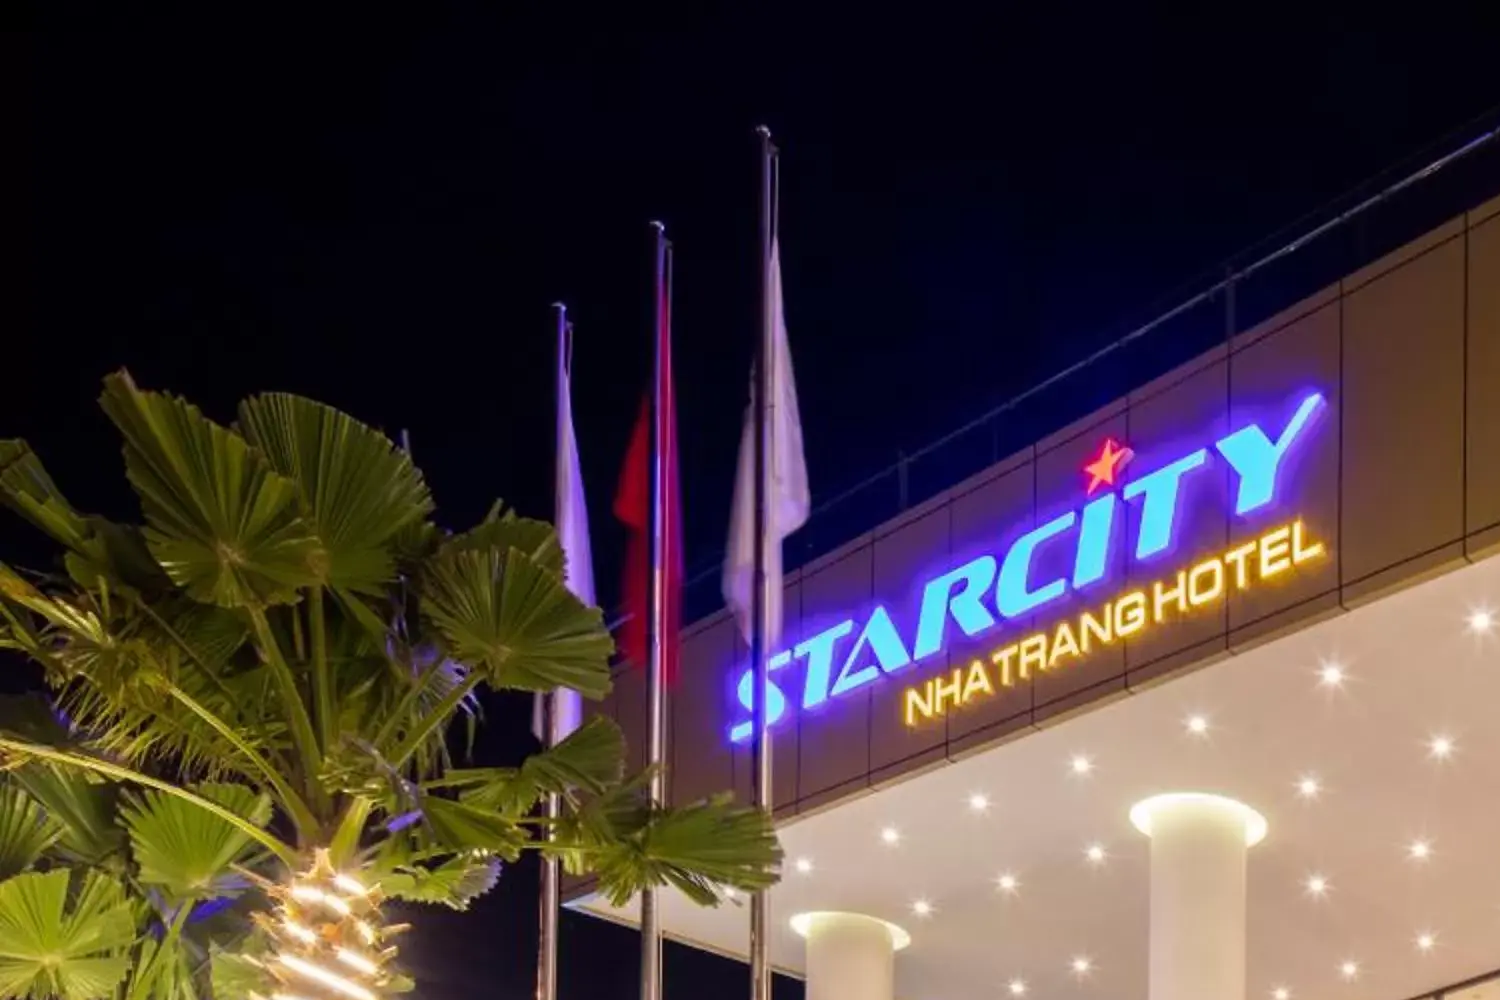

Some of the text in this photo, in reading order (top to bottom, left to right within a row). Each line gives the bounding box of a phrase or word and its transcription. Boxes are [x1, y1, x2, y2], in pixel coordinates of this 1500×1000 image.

[731, 392, 1324, 742] STARCITY
[904, 521, 1324, 726] NHA TRANG HOTEL
